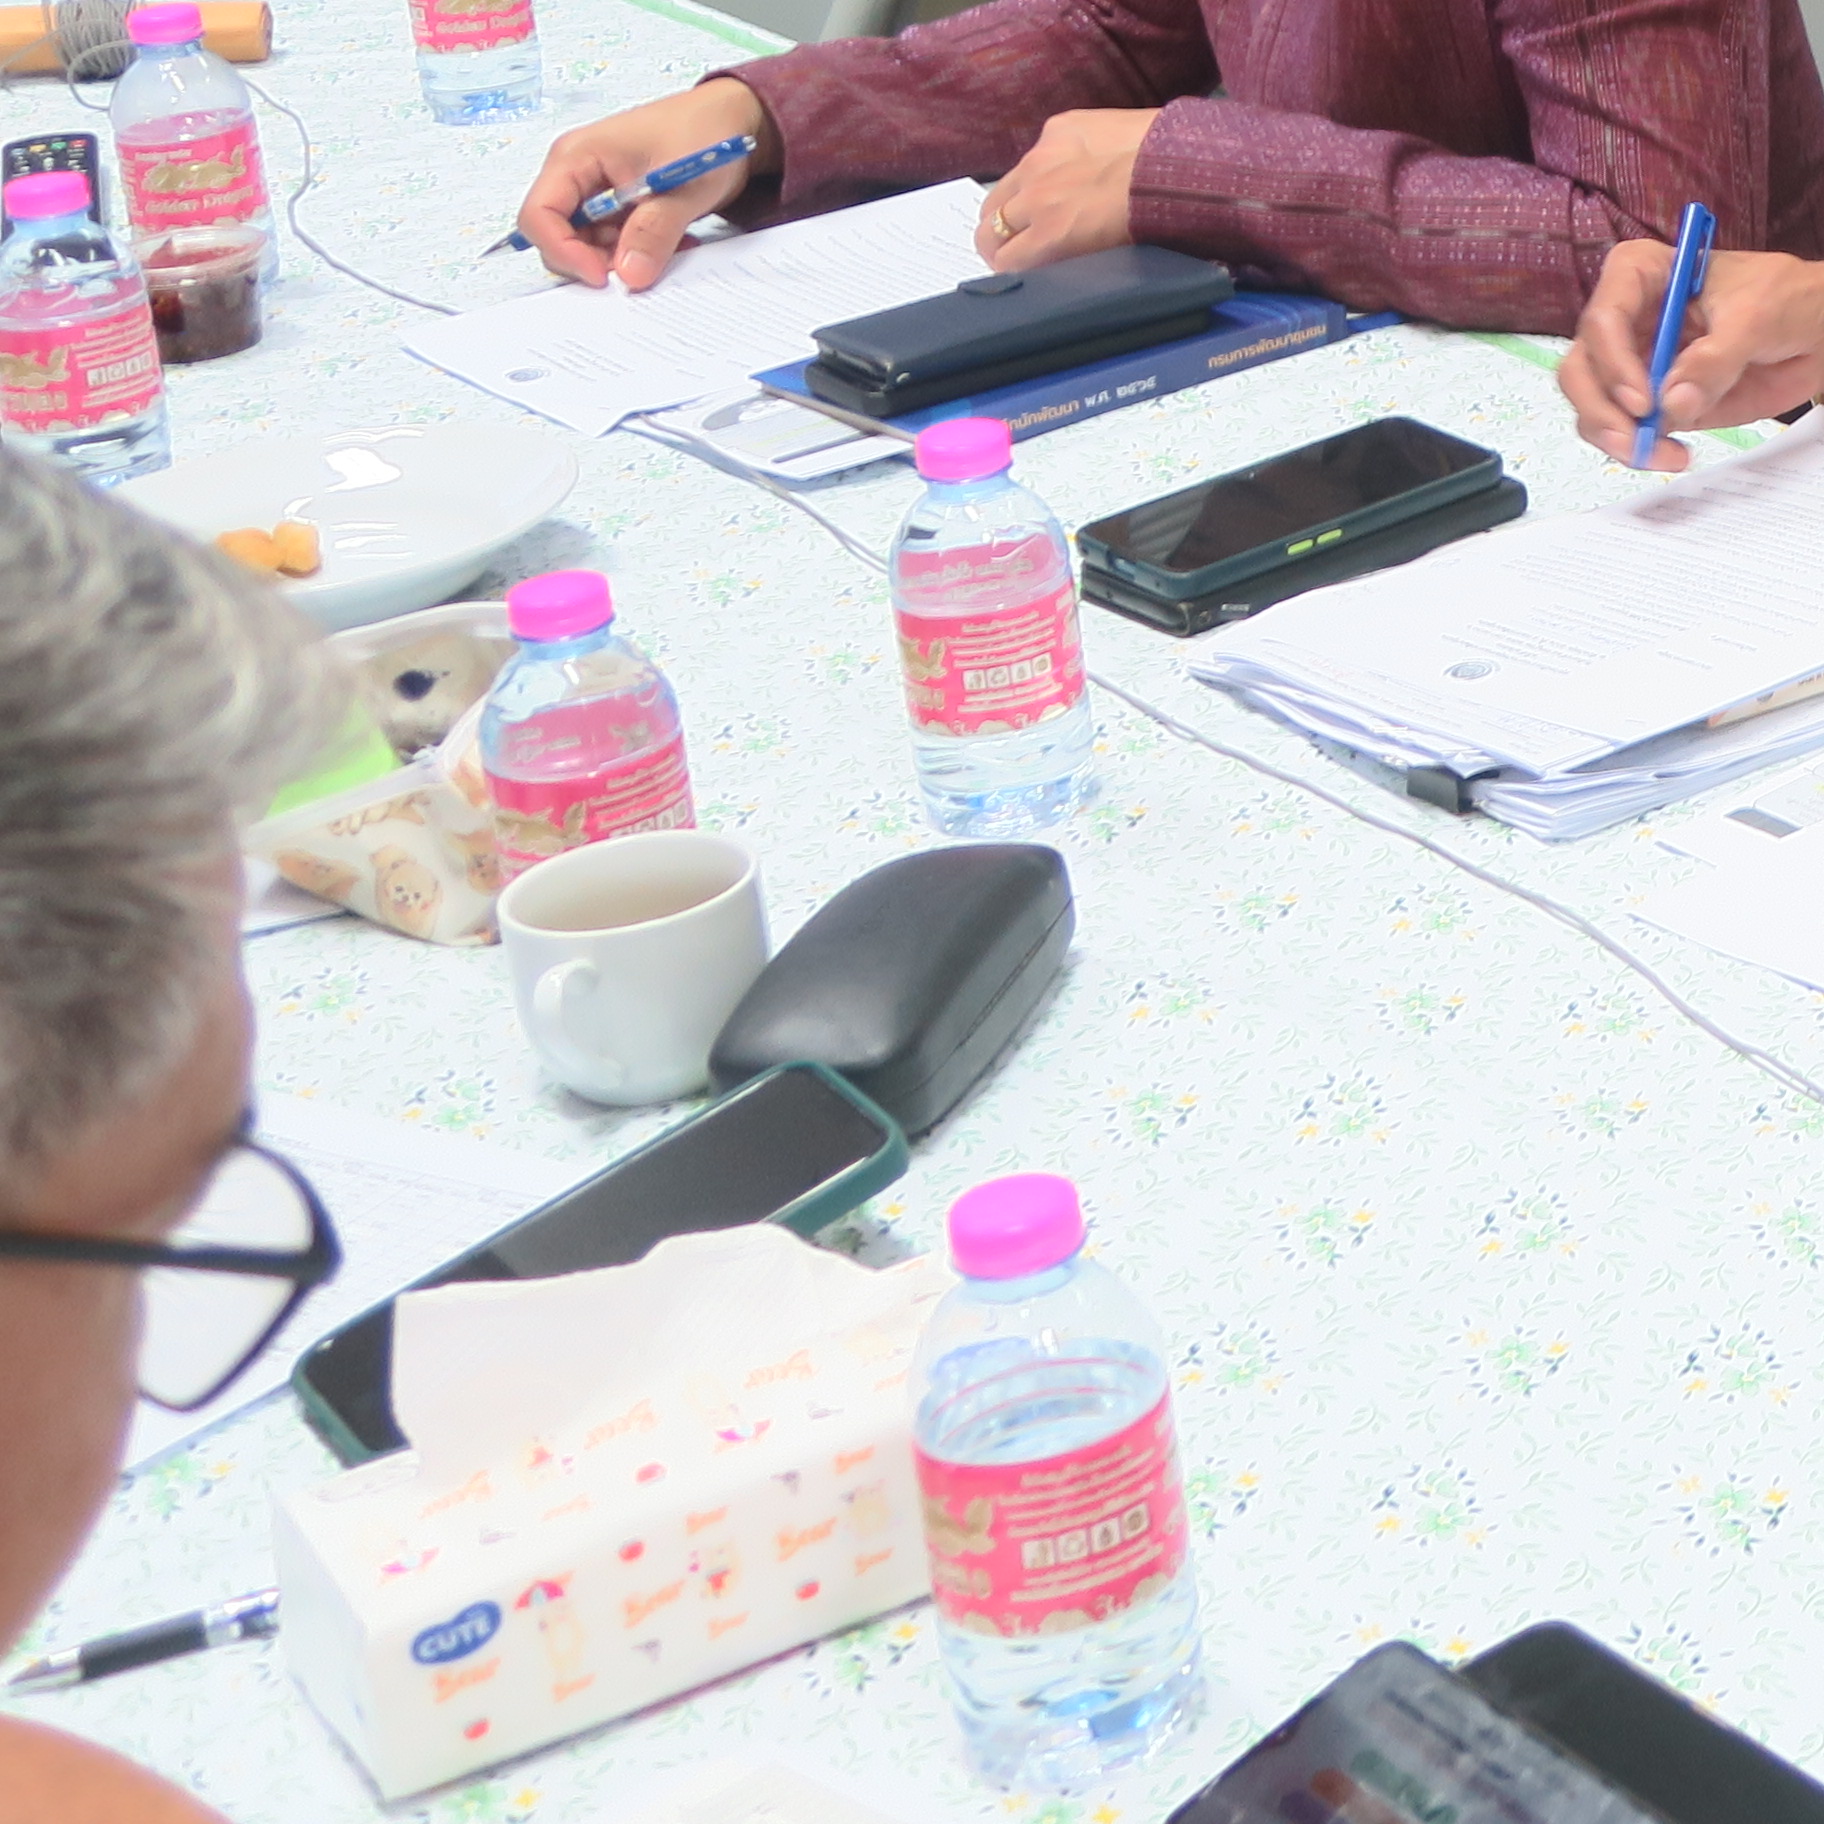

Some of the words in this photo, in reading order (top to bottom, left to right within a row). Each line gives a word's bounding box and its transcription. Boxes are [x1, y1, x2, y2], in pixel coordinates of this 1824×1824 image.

[1207, 322, 1328, 370] กรมการพัฒนาชุมชน
